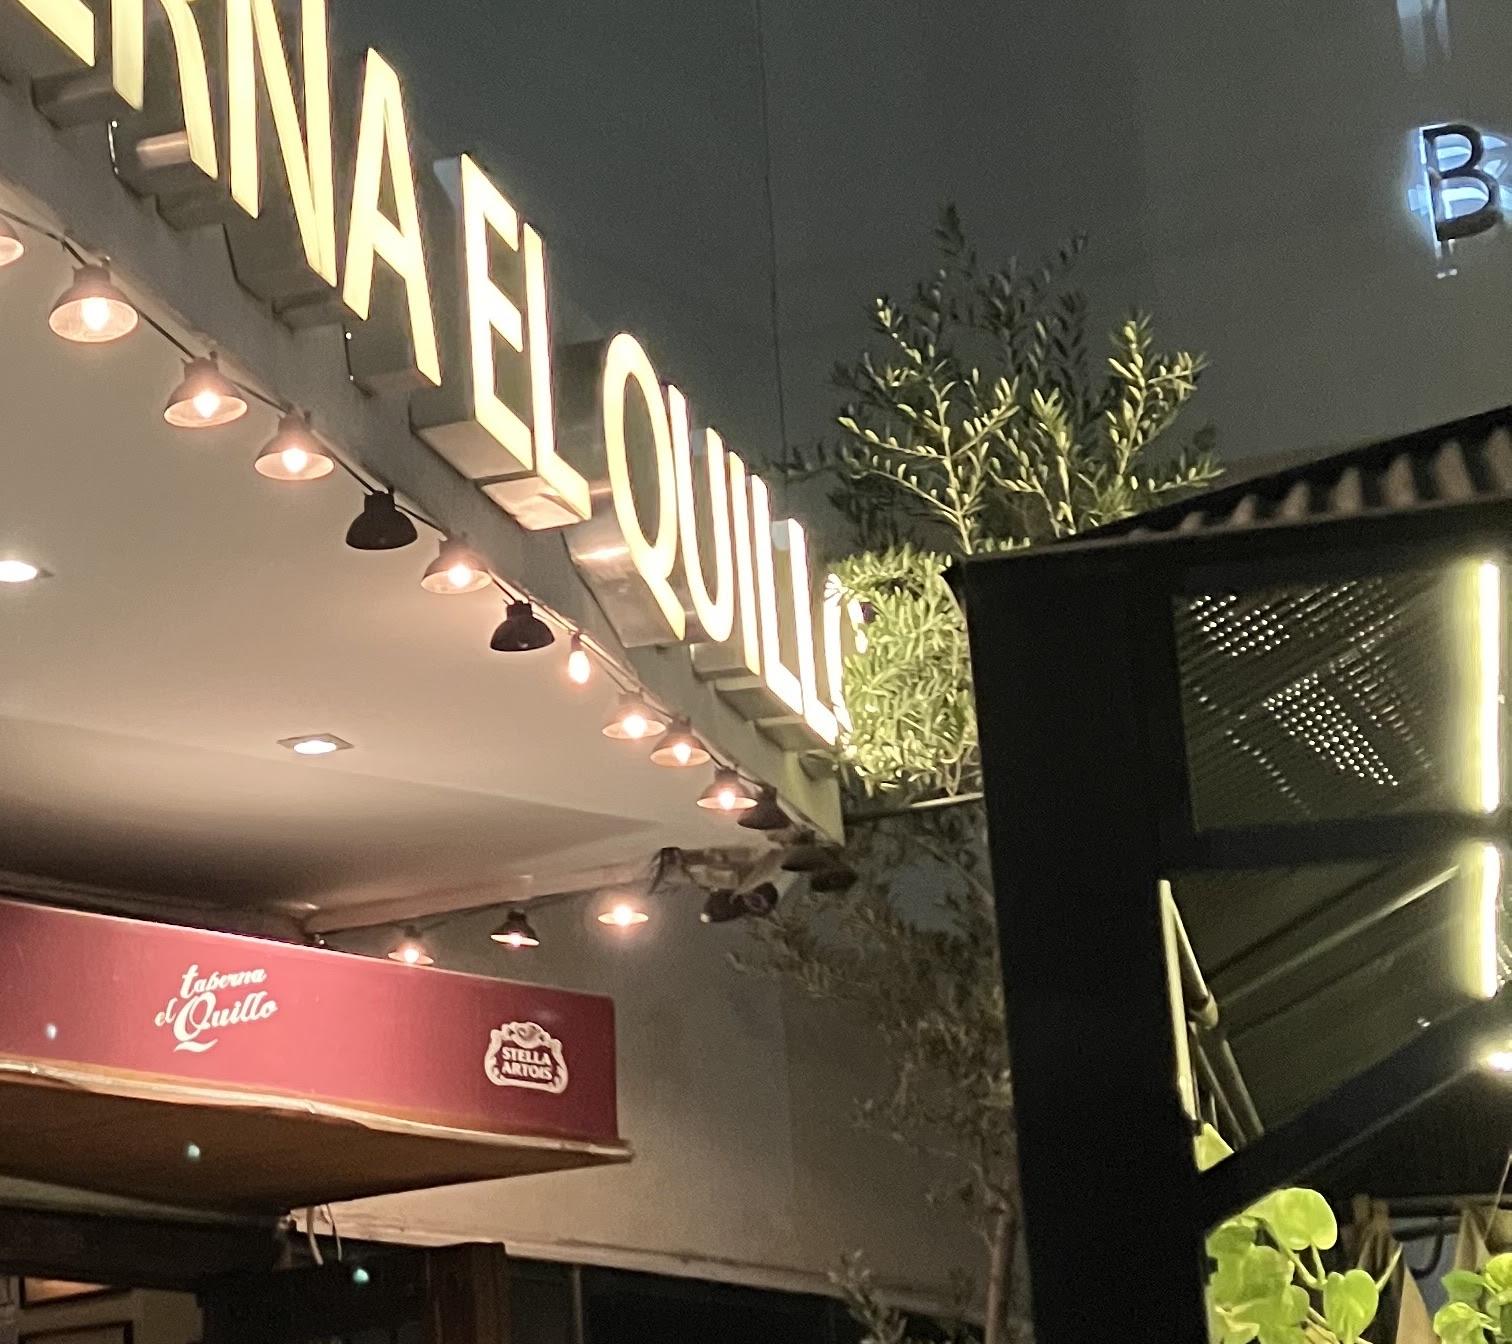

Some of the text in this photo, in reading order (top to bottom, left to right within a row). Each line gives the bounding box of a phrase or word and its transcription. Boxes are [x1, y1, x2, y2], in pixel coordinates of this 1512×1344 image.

[1422, 122, 1501, 242] B
[460, 152, 592, 522] EL
[179, 963, 267, 999] taberna
[154, 990, 278, 1053] el Quillo
[500, 1060, 553, 1081] ARTOIS
[501, 1046, 552, 1067] STELLA
